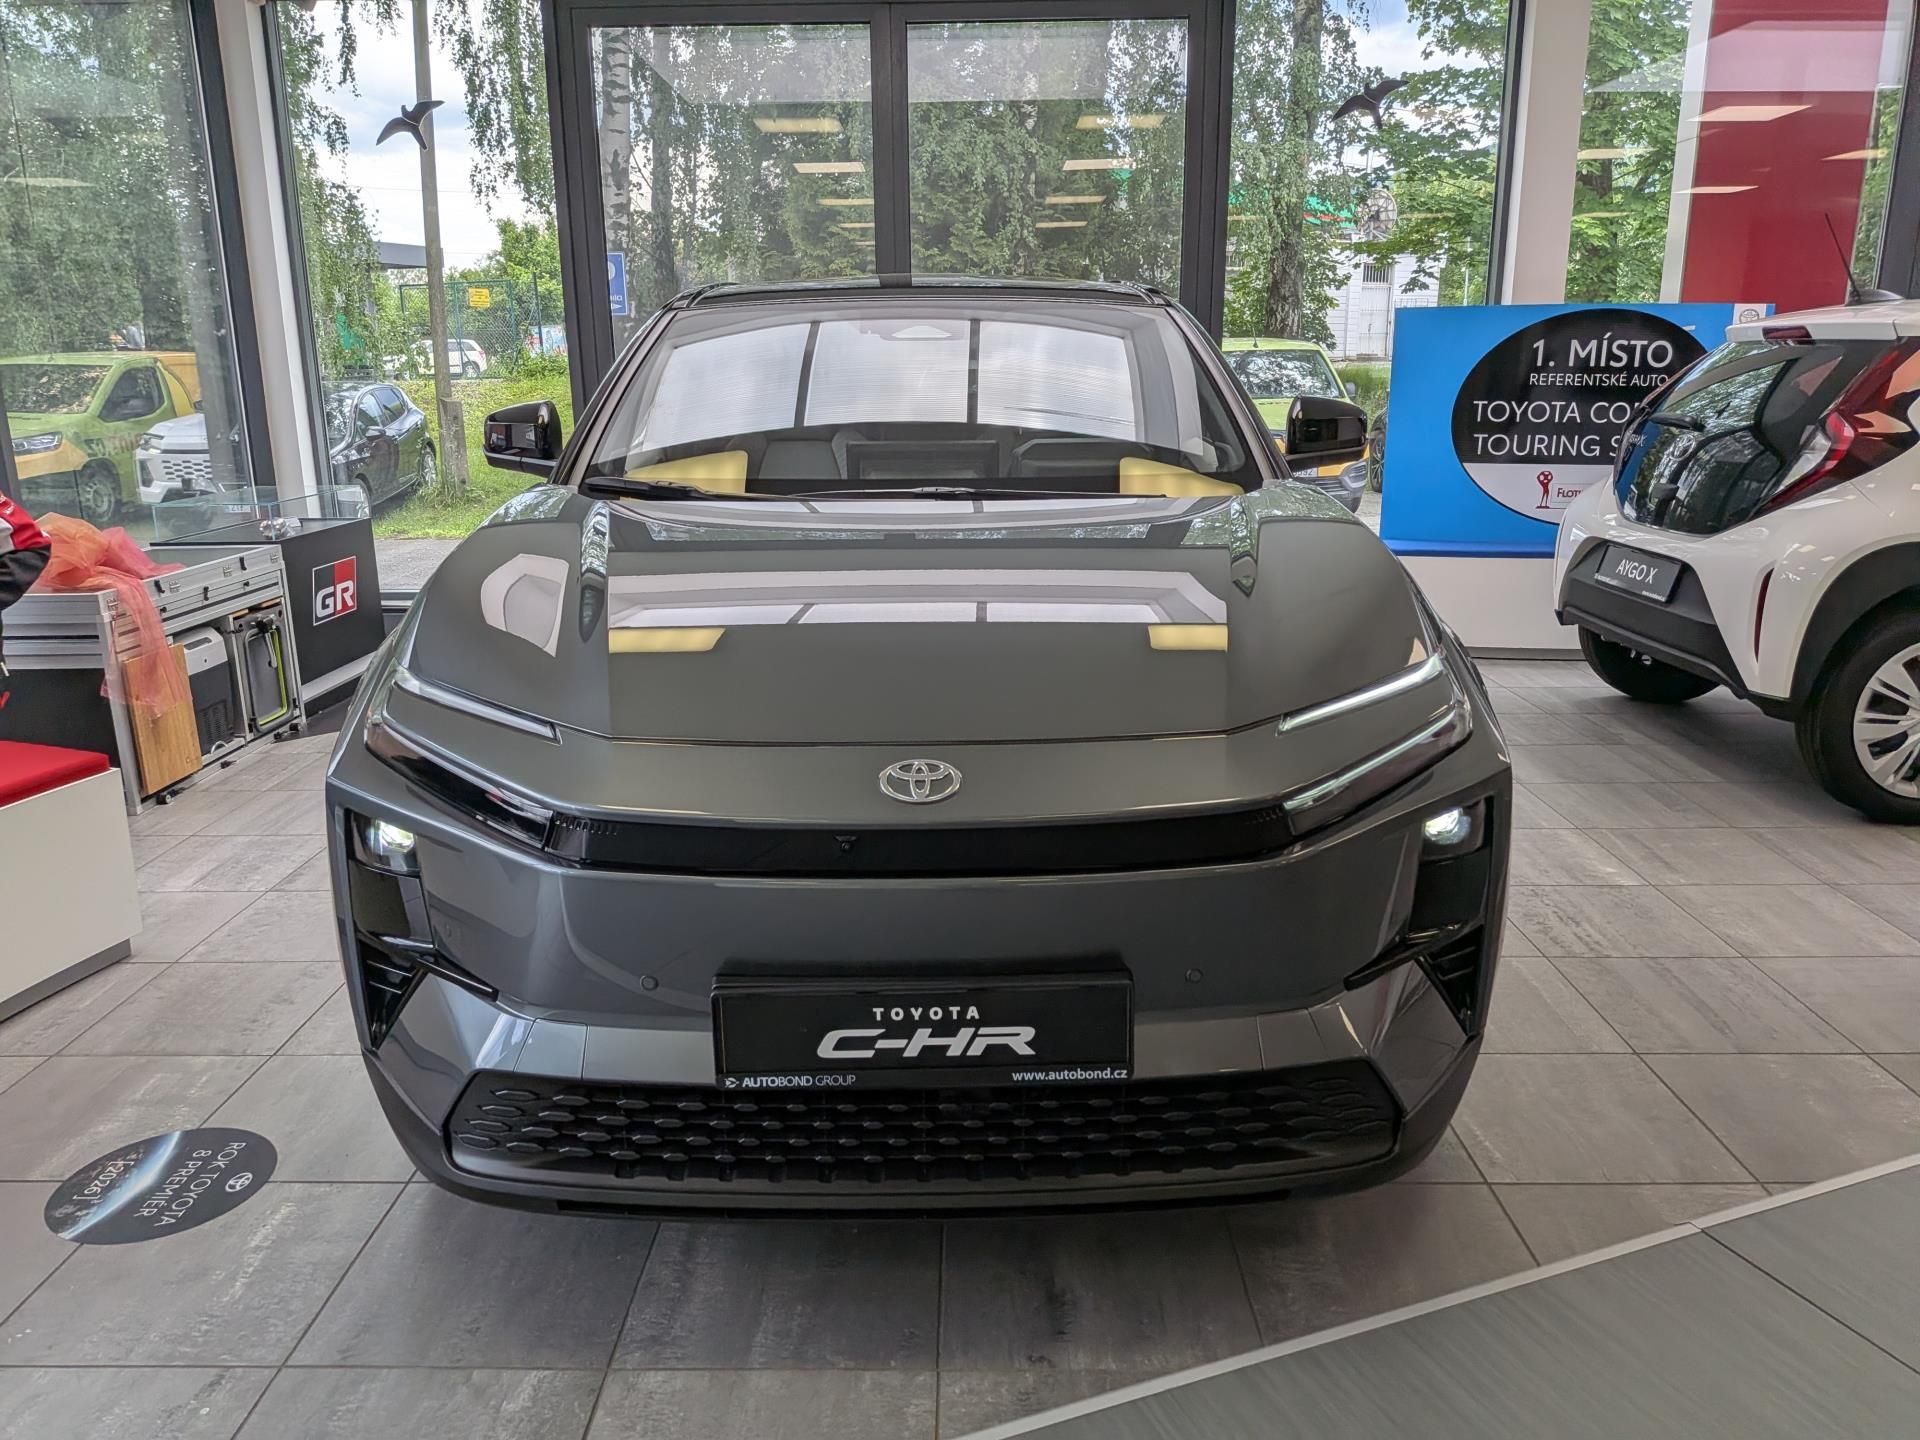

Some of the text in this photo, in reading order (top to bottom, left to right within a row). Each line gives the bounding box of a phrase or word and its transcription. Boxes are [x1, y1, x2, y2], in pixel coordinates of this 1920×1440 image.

[1532, 332, 1673, 368] 1. MÍSTO
[1529, 371, 1627, 386] REFERENTSKÉ
[1473, 401, 1641, 424] TOYOTA CO
[1473, 434, 1601, 457] TOURING
[1615, 559, 1648, 581] AYGO
[1645, 567, 1659, 584] X
[316, 580, 354, 618] GR
[872, 1006, 980, 1022] TOYOTA
[816, 1026, 1036, 1059] C-HR
[742, 1074, 856, 1088] AUTOBOND GROUP
[1012, 1067, 1128, 1083] www.autobond.cz
[133, 1148, 212, 1218] 8 PREMIÉR
[153, 1142, 246, 1227] ROK TOYOTA
